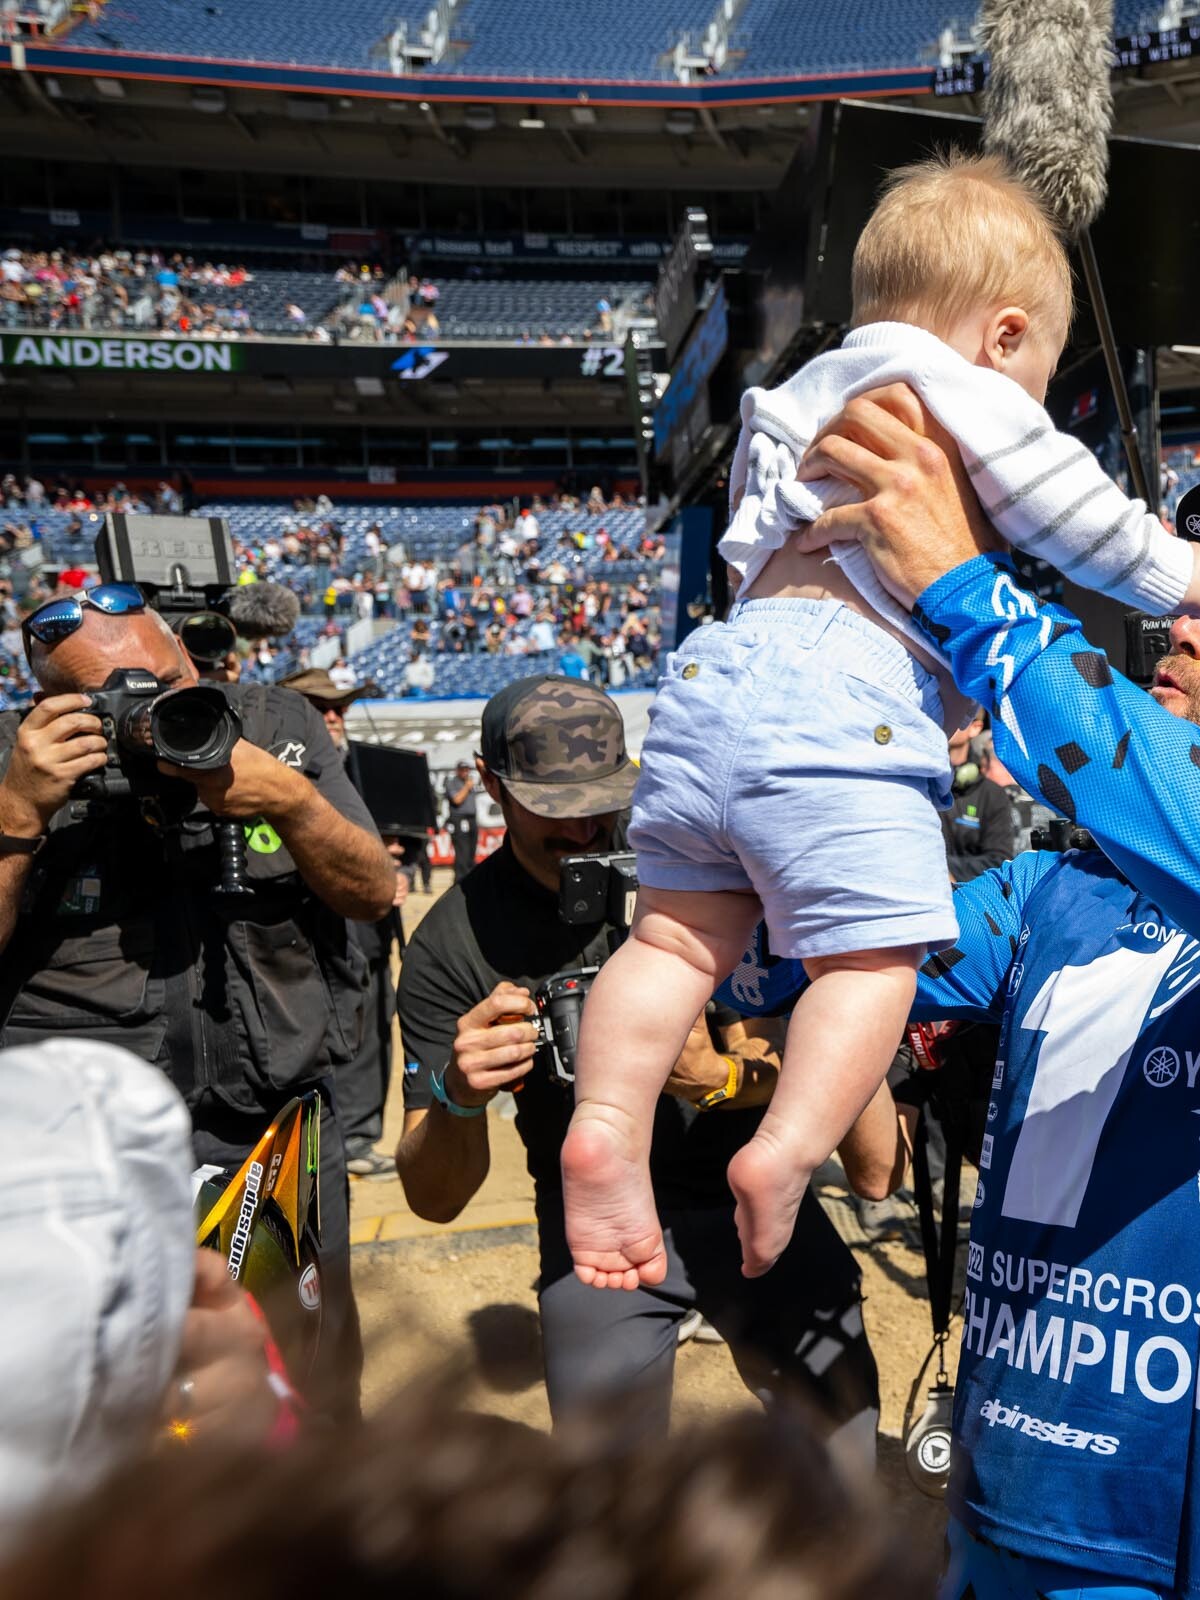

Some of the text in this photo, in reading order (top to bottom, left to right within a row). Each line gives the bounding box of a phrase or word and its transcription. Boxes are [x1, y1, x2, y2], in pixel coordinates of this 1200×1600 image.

[1130, 33, 1151, 49] TO
[1159, 29, 1179, 45] BE
[1148, 41, 1192, 61] WITH
[14, 336, 232, 371] ANDERSON
[1141, 619, 1160, 631] RYAN
[129, 680, 158, 690] Canon
[979, 1398, 1121, 1456] alpinestars
